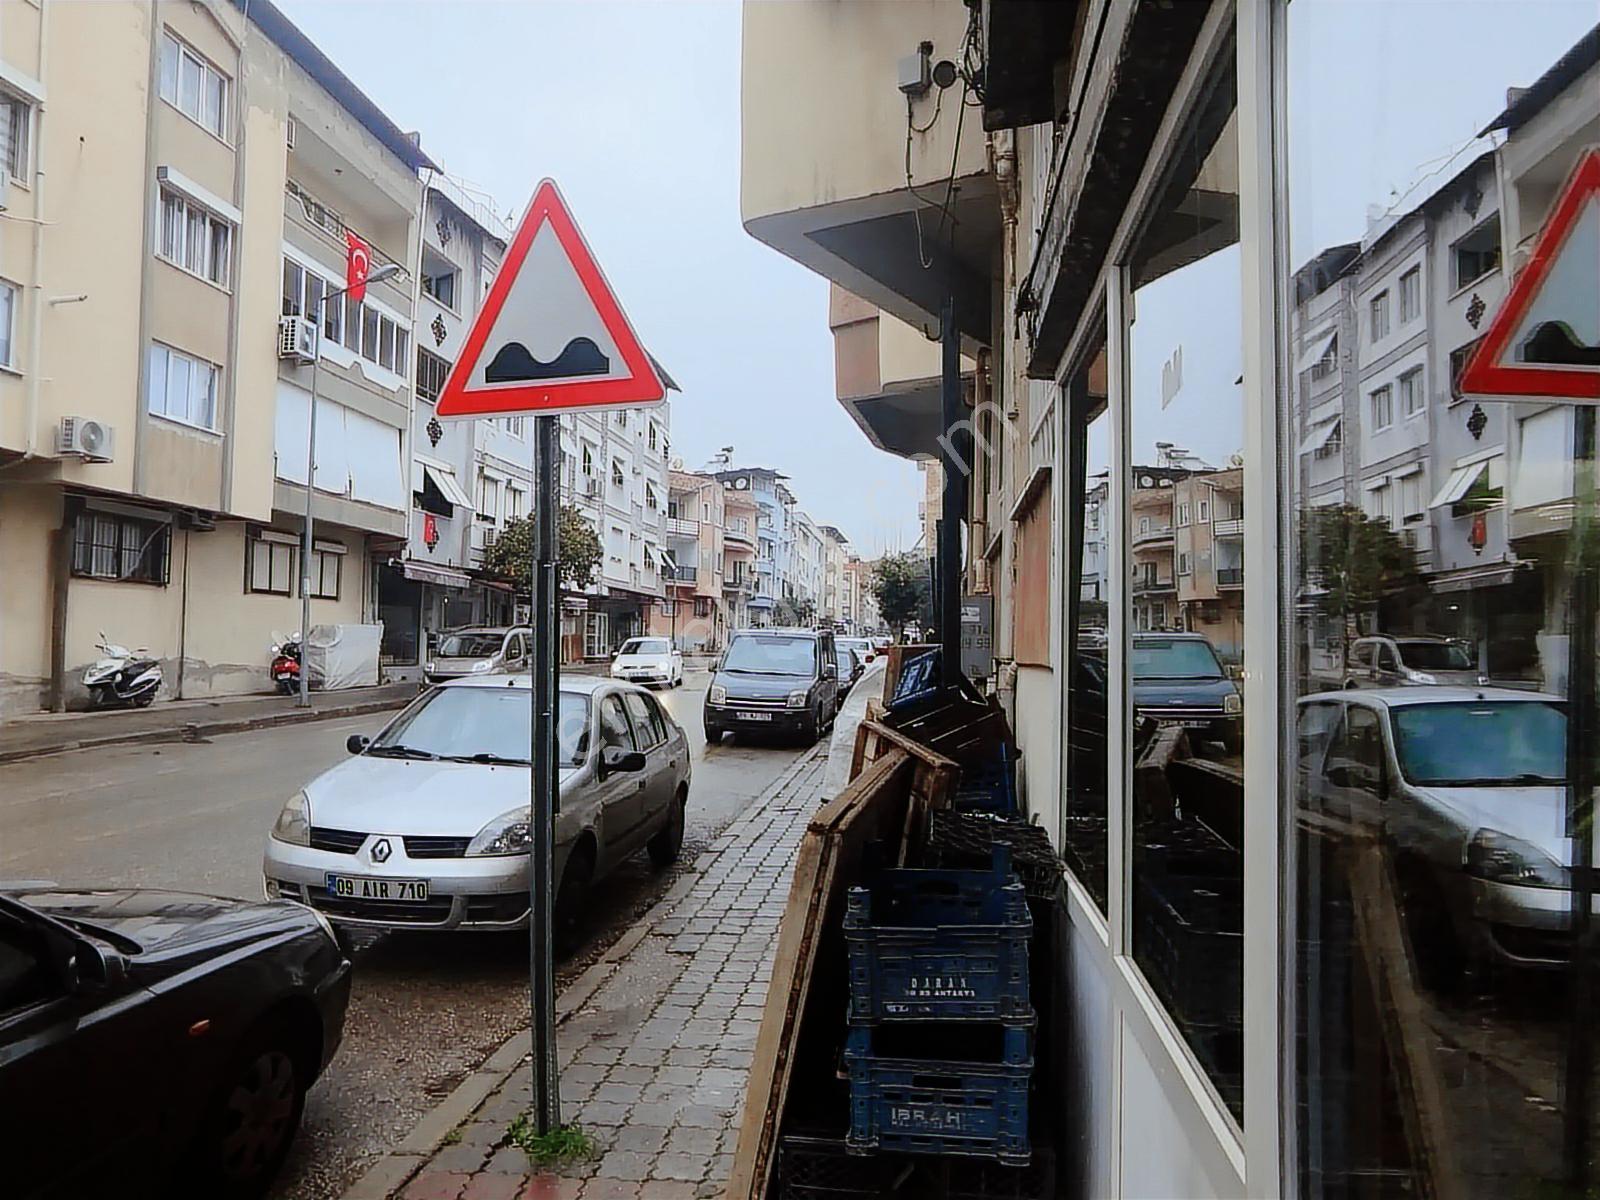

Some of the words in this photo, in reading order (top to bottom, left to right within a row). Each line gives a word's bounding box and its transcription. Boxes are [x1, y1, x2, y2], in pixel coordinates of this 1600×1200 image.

[337, 878, 354, 896] 09
[363, 881, 389, 898] AIR
[398, 882, 426, 899] 710
